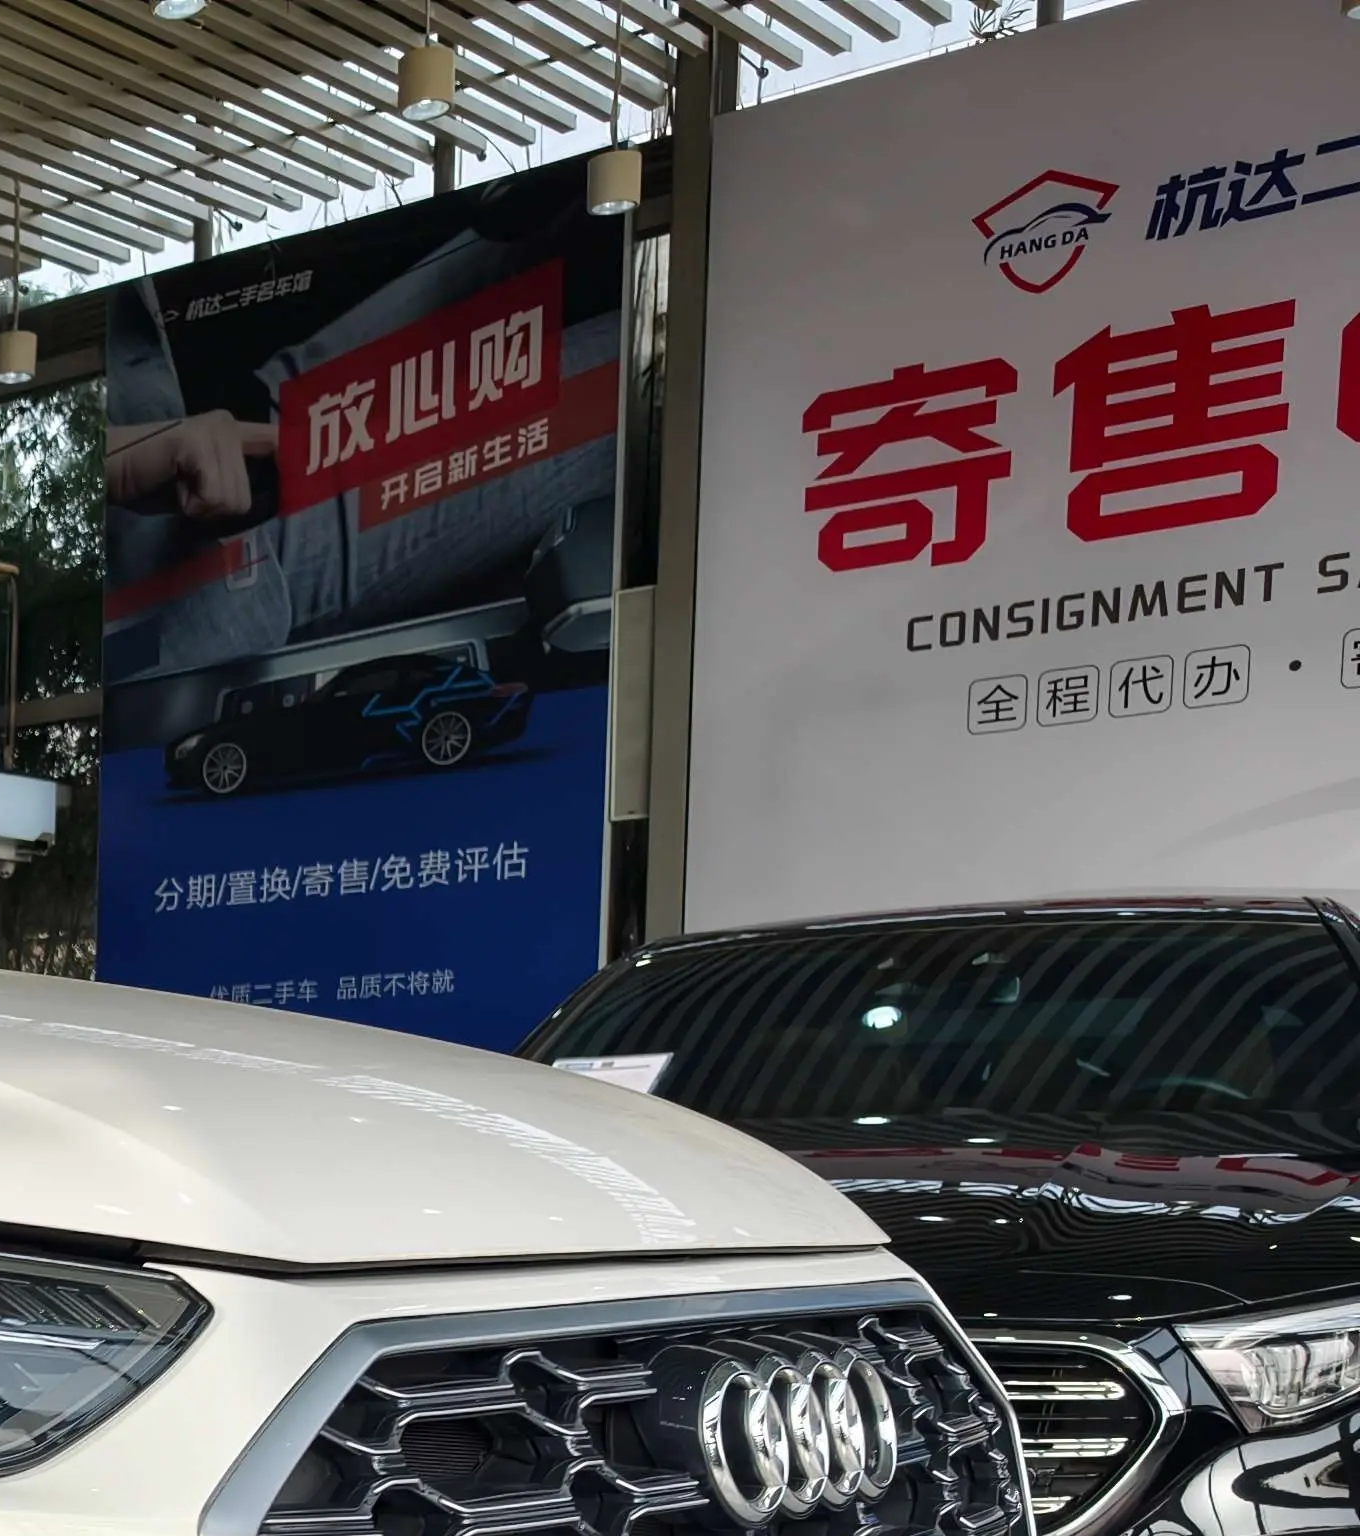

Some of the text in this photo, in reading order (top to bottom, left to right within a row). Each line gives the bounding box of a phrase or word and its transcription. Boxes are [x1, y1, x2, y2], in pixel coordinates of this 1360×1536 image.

[999, 226, 1089, 261] HANG DA
[306, 305, 544, 476] 放心购
[381, 418, 549, 510] 开启新生活
[802, 299, 1360, 573] 寄售
[906, 551, 1360, 653] CONSIGNMENT S
[976, 655, 1241, 726] 全程代办
[154, 841, 530, 913] 分期/置换/寄售/免费评估
[336, 968, 455, 1001] 品质不将就
